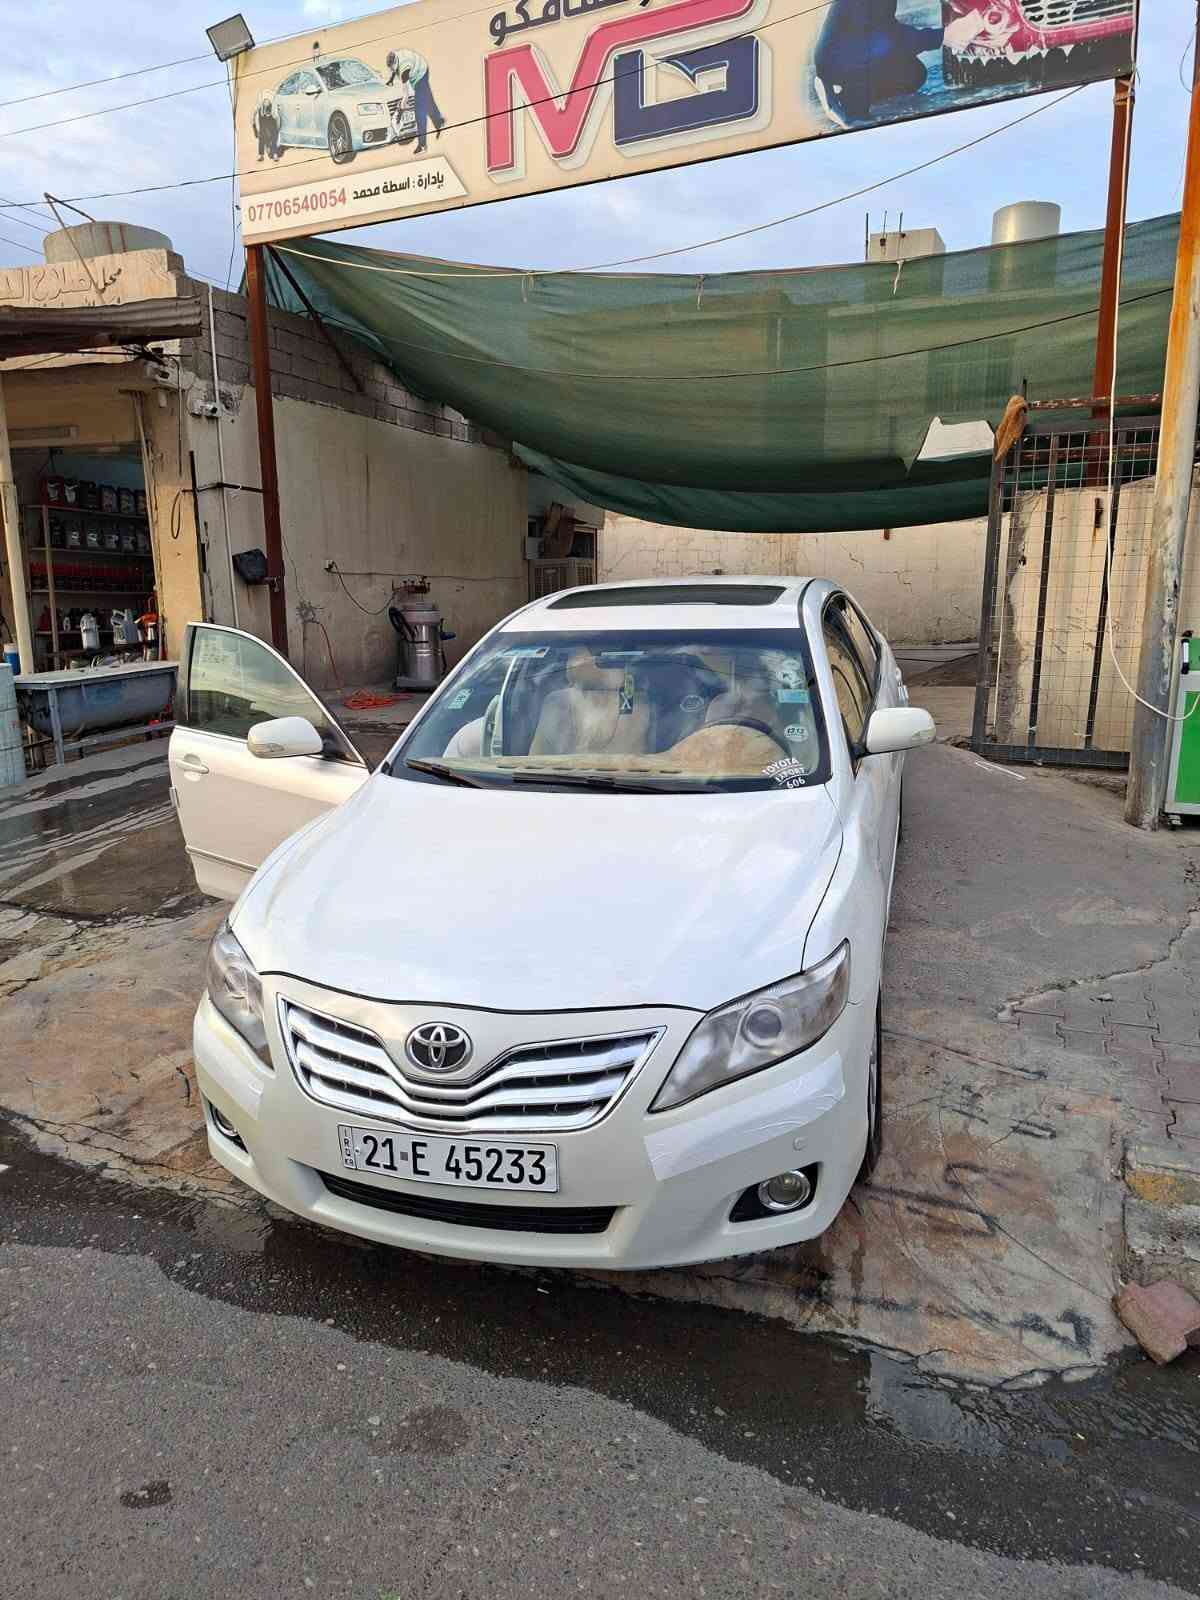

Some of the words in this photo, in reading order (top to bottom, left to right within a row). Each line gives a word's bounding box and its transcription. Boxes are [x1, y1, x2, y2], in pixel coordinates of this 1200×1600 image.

[353, 185, 381, 200] محمد
[248, 187, 347, 222] 07706540054
[762, 757, 800, 775] TOYOTA
[786, 777, 806, 789] 606
[362, 1135, 398, 1171] 21
[411, 1141, 430, 1176] E
[445, 1144, 547, 1186] 45233
